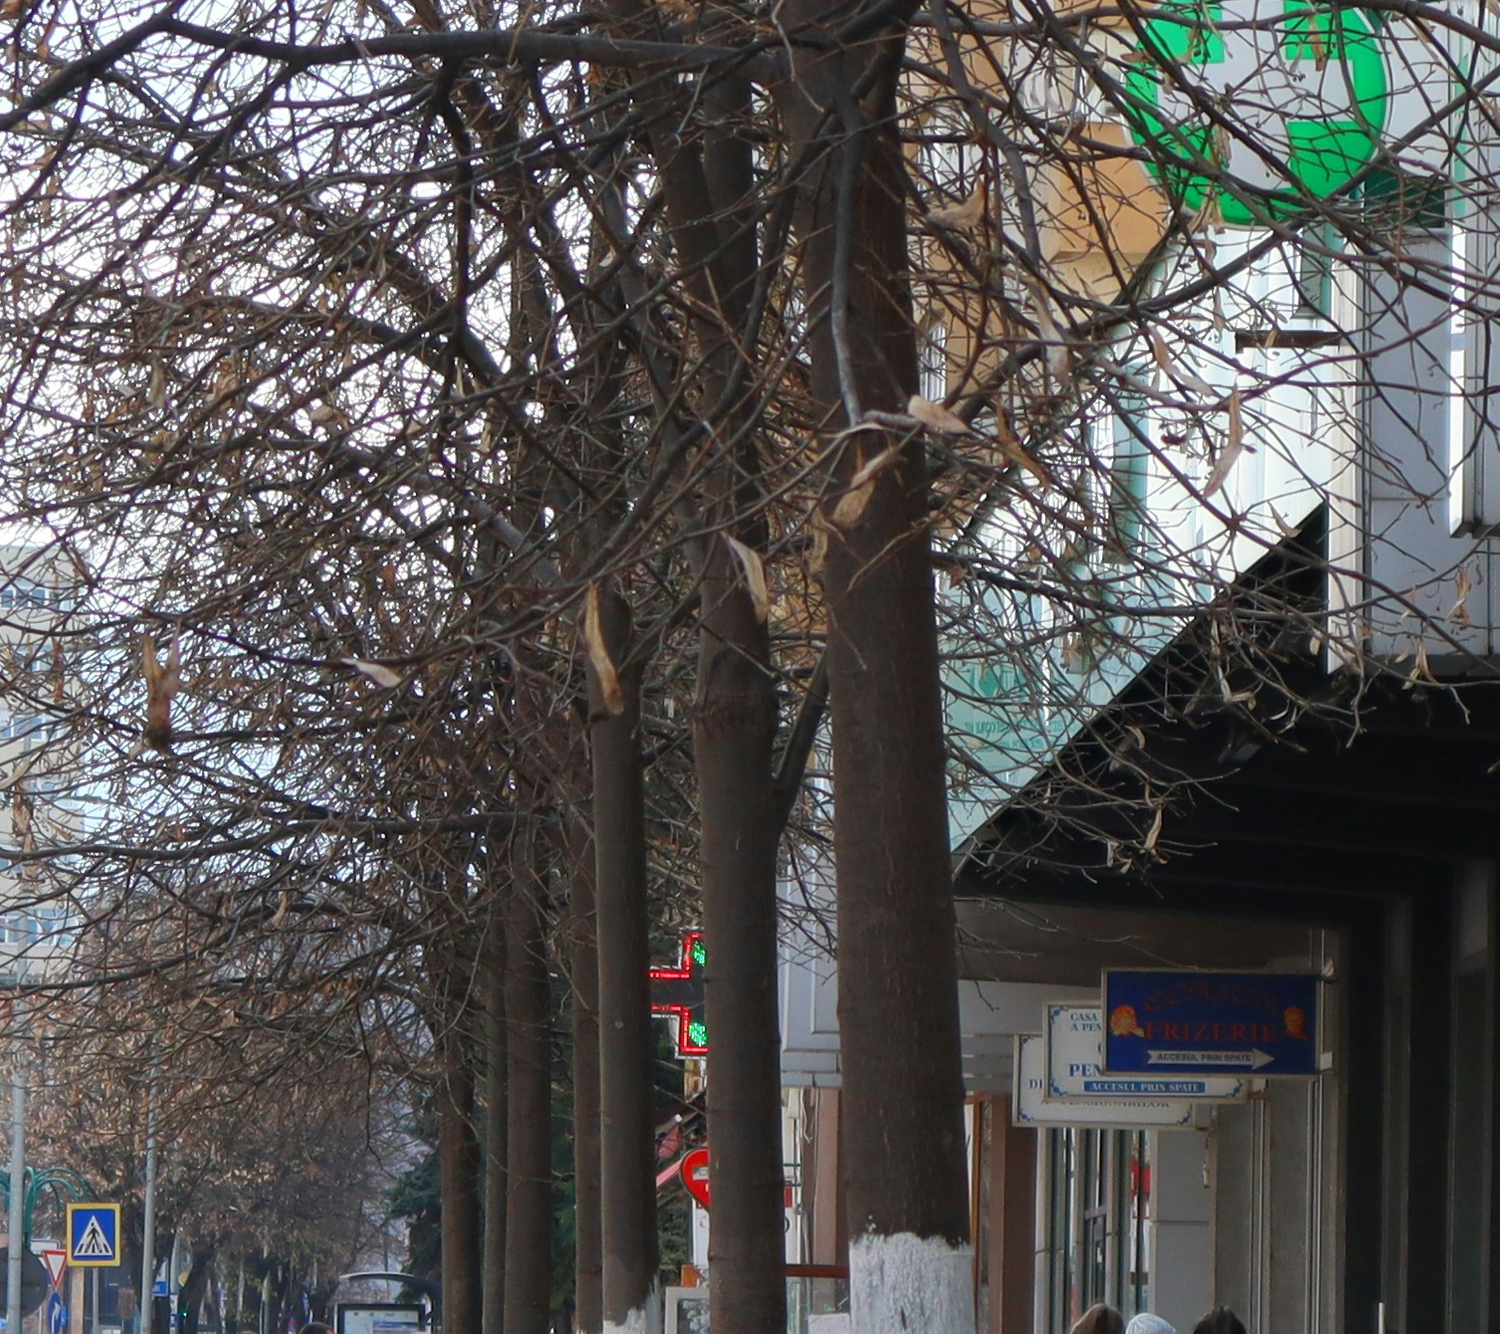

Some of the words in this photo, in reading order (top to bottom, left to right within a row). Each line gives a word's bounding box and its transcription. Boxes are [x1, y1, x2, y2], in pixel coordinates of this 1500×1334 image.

[1070, 1012, 1098, 1023] CASA
[1145, 1022, 1278, 1042] FRIZERIE
[1156, 1052, 1199, 1062] ACCESUL
[1200, 1052, 1222, 1062] PRIN
[1223, 1052, 1251, 1062] SPATE
[1091, 1082, 1138, 1092] ACCESUL
[1140, 1082, 1165, 1092] PRIN
[1168, 1082, 1200, 1092] SPATE
